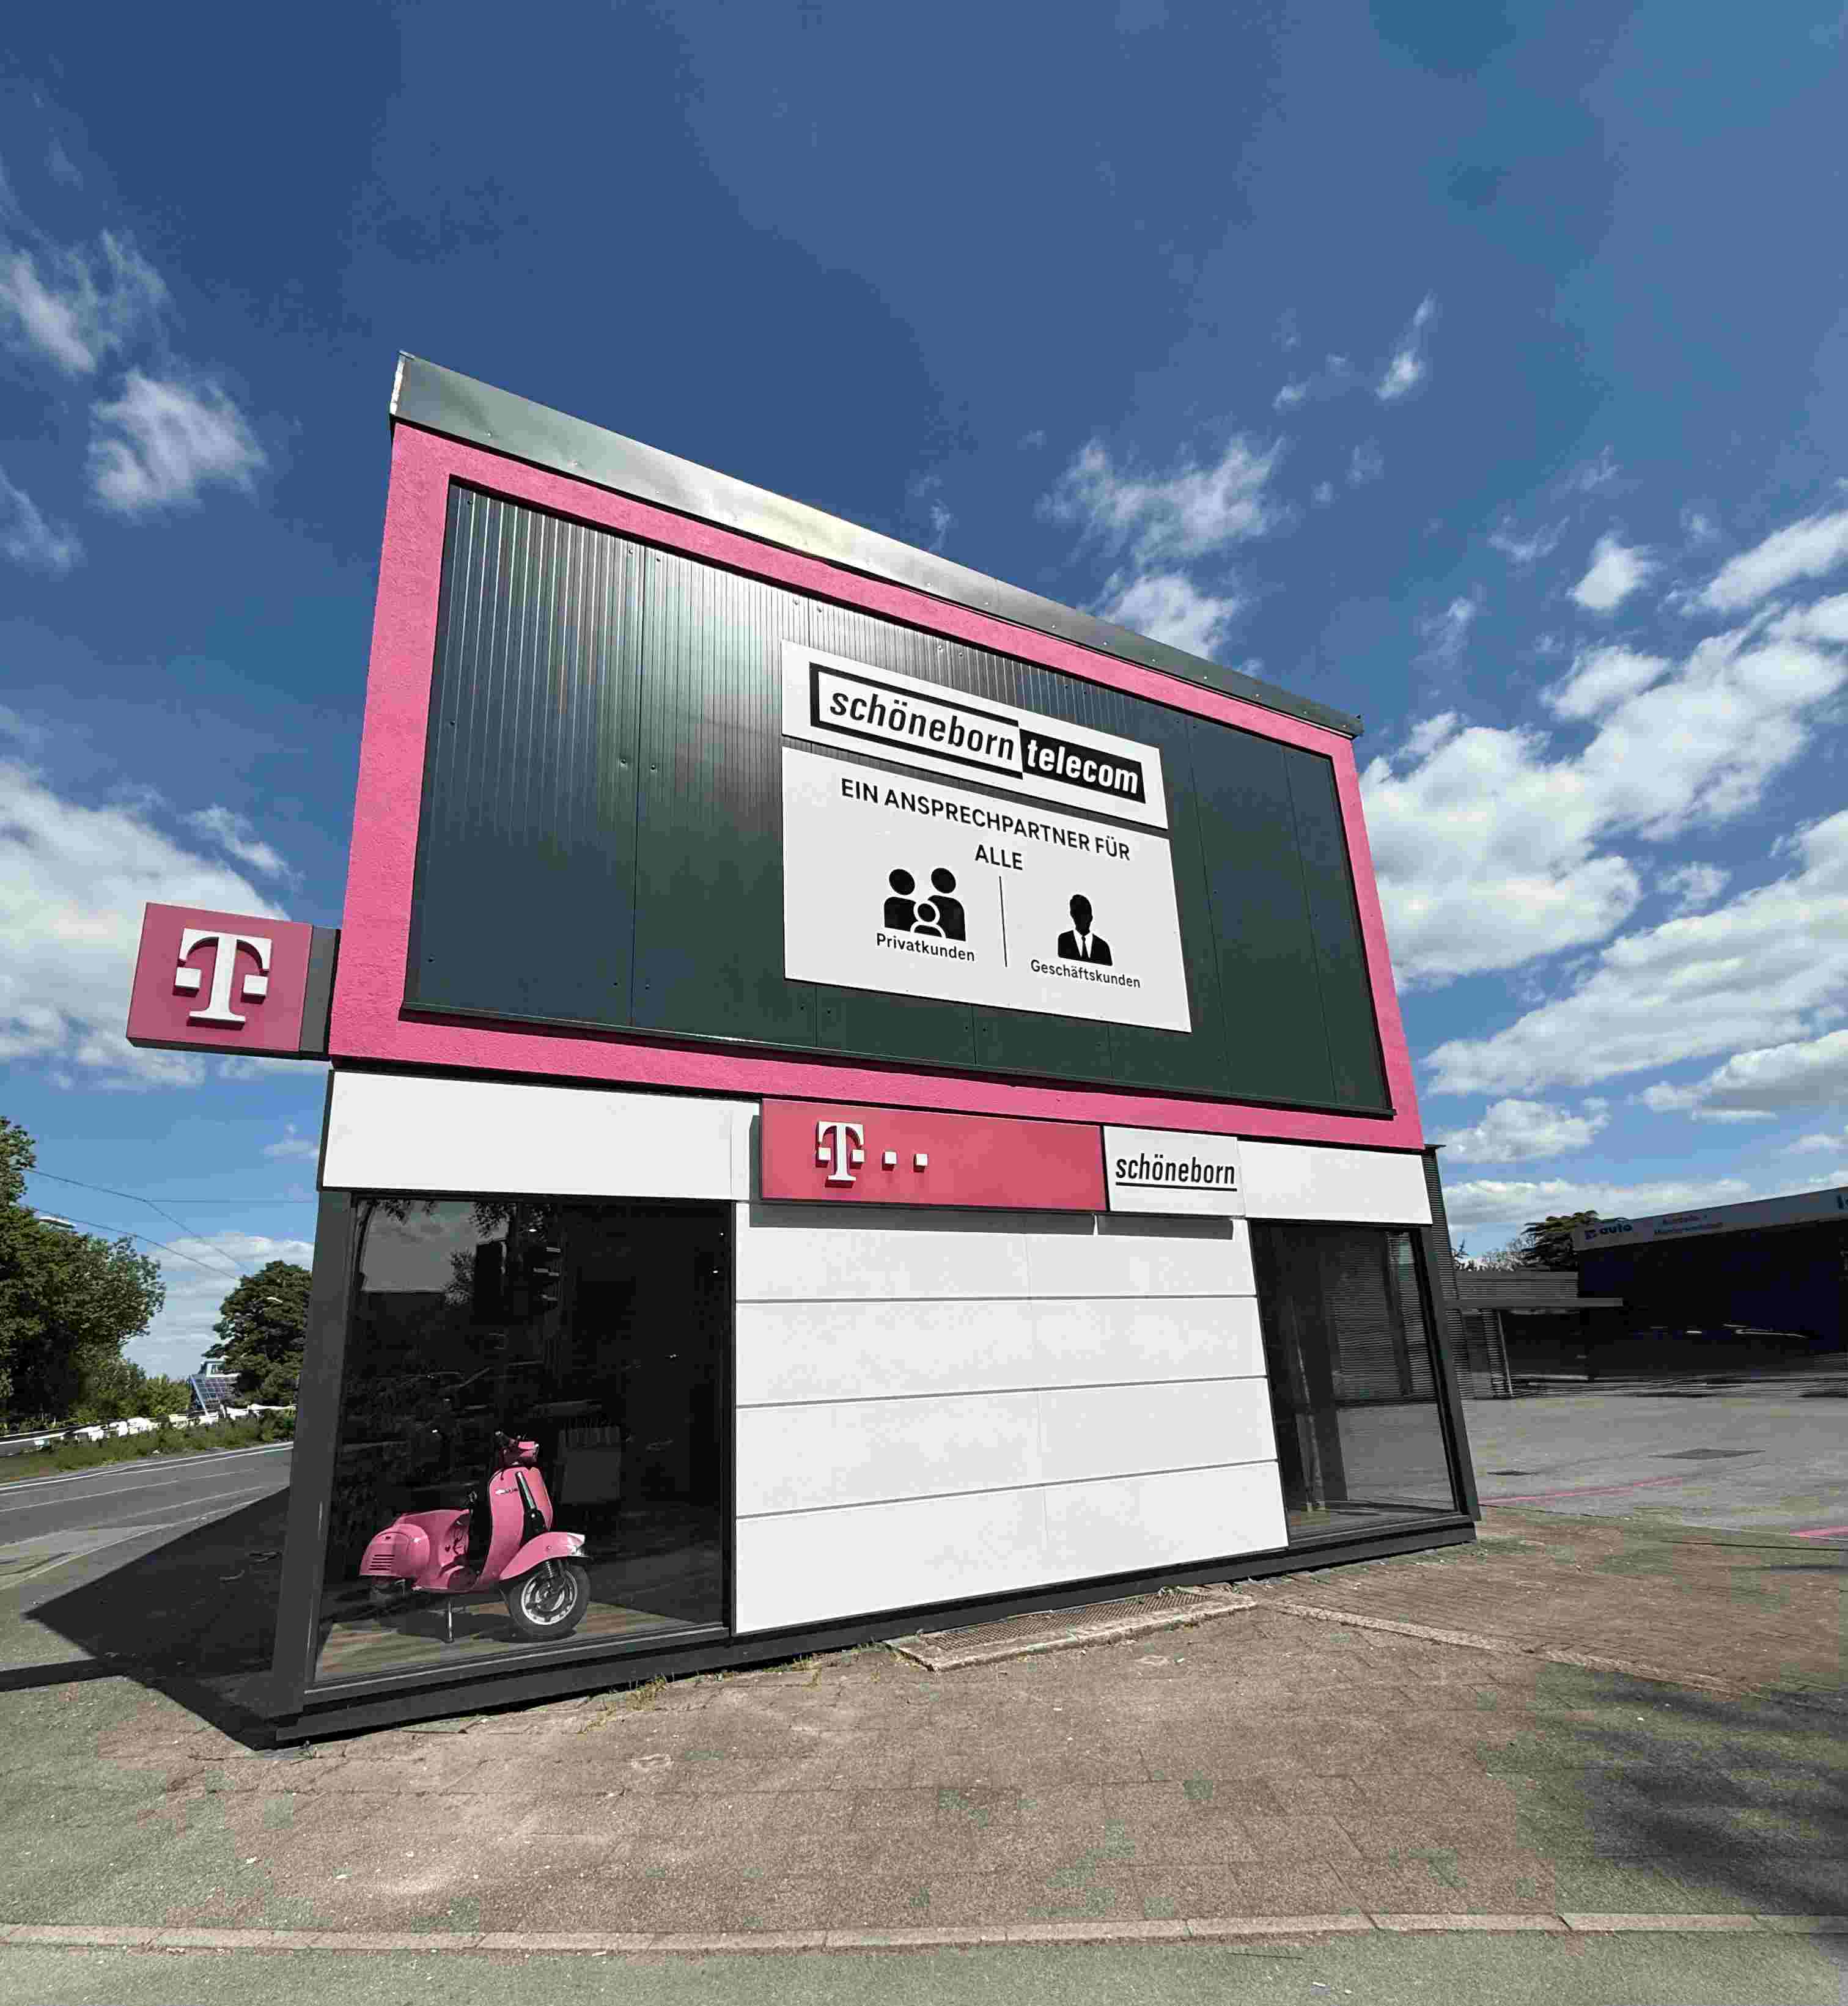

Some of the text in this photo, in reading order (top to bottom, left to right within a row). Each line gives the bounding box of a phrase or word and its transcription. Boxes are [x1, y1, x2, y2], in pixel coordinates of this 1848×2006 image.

[830, 693, 1138, 793] schöneborn telecom
[841, 777, 1130, 861] EIN ANSPRECHPARTNER FÜR
[974, 844, 1023, 871] ALLE
[877, 933, 974, 961] Privatkunden
[175, 928, 272, 1023] T
[1031, 959, 1140, 988] Geschäftskunden
[1115, 1153, 1235, 1185] schöneborn
